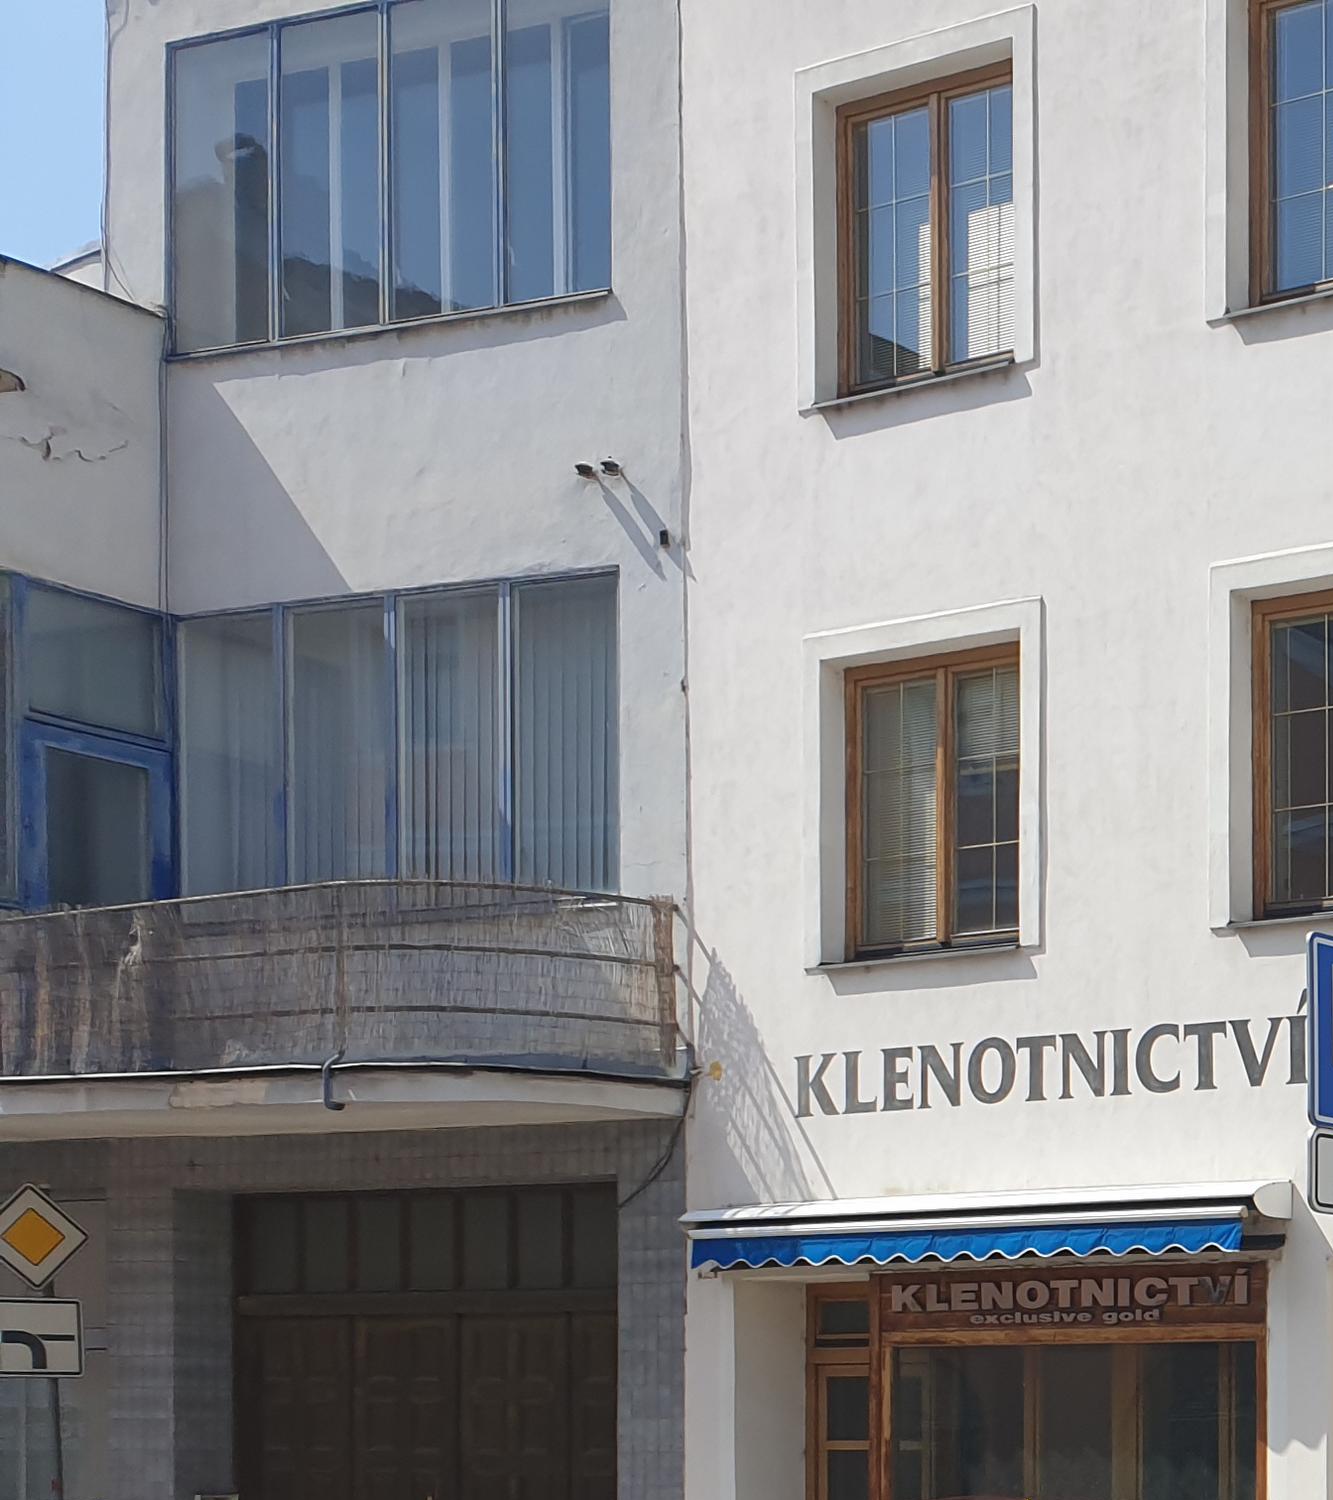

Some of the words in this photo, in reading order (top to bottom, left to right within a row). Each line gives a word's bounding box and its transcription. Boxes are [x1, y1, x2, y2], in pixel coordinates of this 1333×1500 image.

[795, 988, 1307, 1118] KLENOTNICTVÍ
[891, 1269, 1249, 1312] KLENOTNICTVÍ
[970, 1309, 1093, 1325] exclusive
[1102, 1308, 1161, 1326] gold
